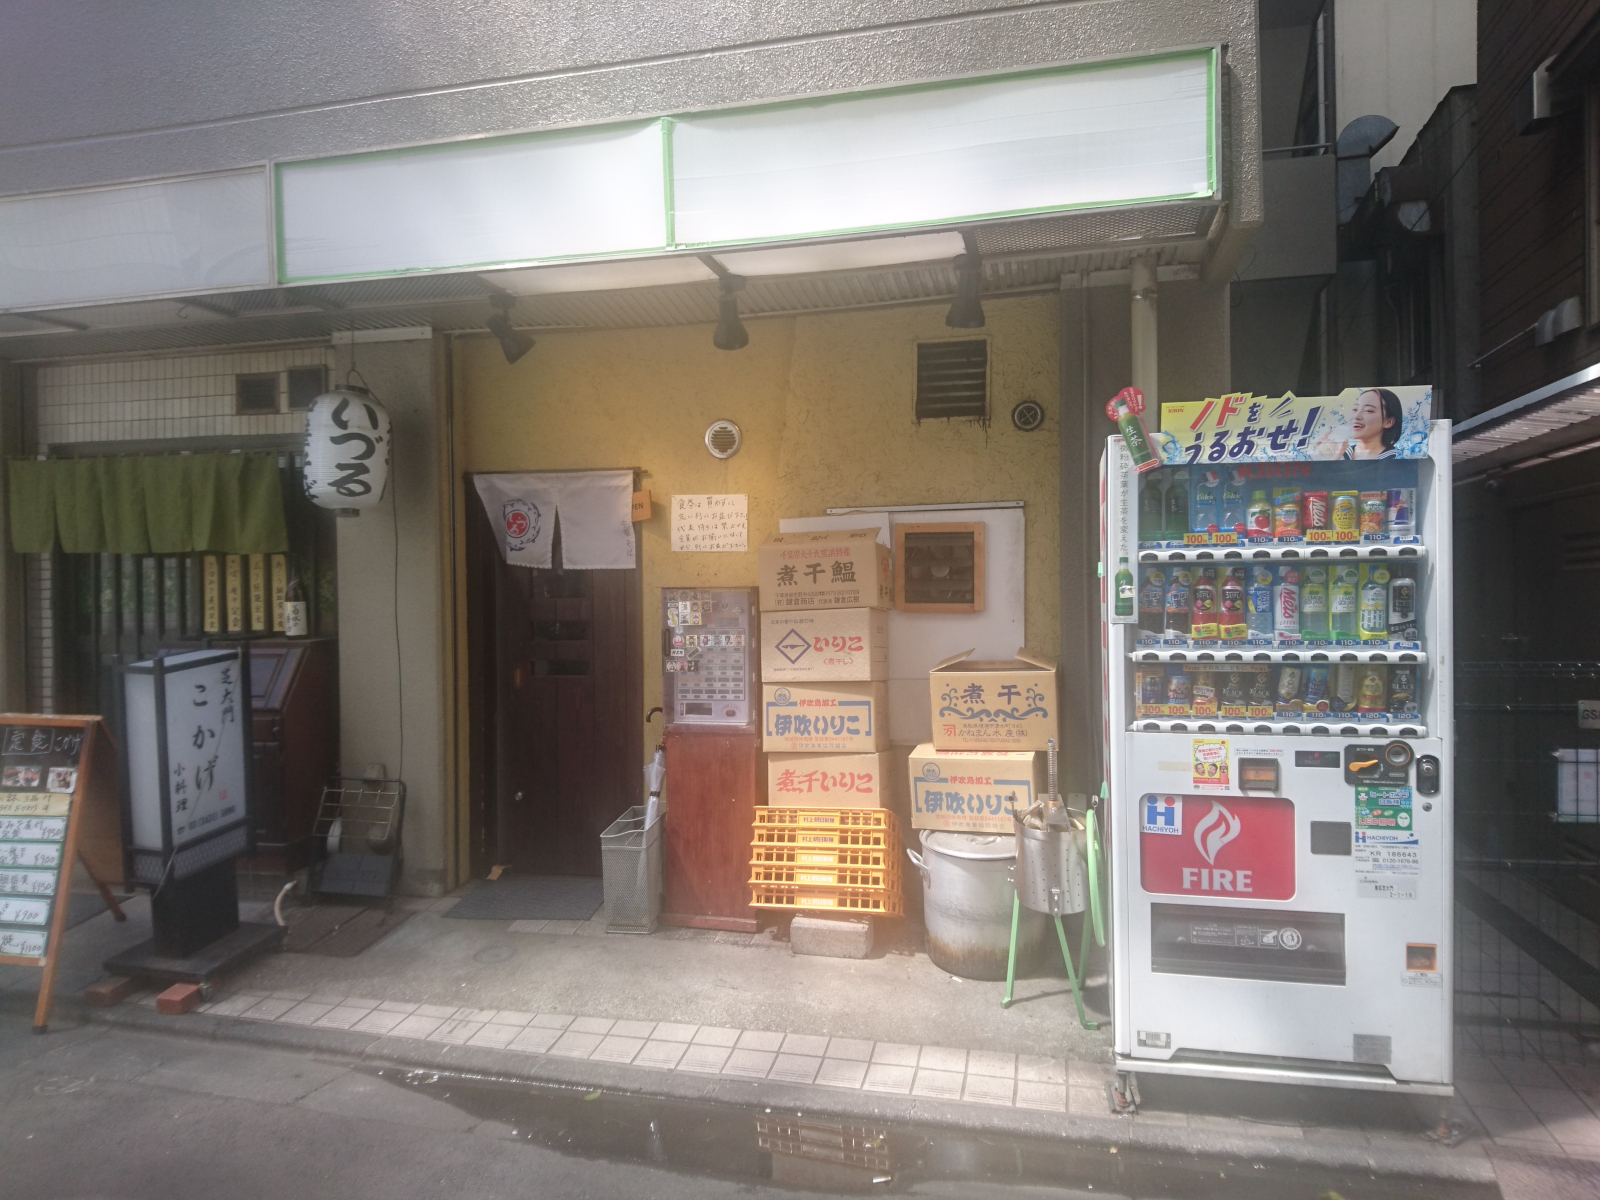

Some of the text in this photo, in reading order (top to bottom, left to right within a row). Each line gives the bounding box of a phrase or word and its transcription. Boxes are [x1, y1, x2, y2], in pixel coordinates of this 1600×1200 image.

[1189, 396, 1263, 431] ノドを
[1126, 426, 1142, 446] 生茶
[1185, 406, 1323, 463] うるおせ!
[328, 397, 383, 497] いづる
[1238, 462, 1311, 479] KIRIN
[1313, 498, 1324, 527] Mets
[1186, 534, 1208, 543] 100円
[1214, 534, 1236, 542] 100円
[1309, 532, 1331, 541] 100円
[1336, 531, 1357, 540] 100円
[780, 547, 851, 560] 千葉県九十九里浜特産
[1280, 587, 1298, 619] Mets
[813, 636, 864, 652] いりこ
[221, 668, 234, 723] 芝大門
[960, 683, 1022, 705] 煮干
[799, 699, 837, 707] 伊吹島加工
[1144, 705, 1165, 714] 100円
[1168, 706, 1188, 714] 100円
[1194, 706, 1215, 715] 100円
[1224, 707, 1244, 716] 100円
[1250, 708, 1271, 717] 100円
[775, 714, 860, 736] 伊吹いりこ
[8, 730, 49, 752] 定食
[193, 684, 219, 791] こかげ
[776, 769, 873, 794] 煮干いりこ
[949, 776, 992, 786] 伊吹島加工
[173, 763, 188, 813] 小料理
[1370, 790, 1410, 799] ヒートポンプ
[924, 790, 1018, 815] 伊吹いりこ
[1358, 817, 1397, 827] LED照明
[42, 827, 62, 839] ¥950
[1142, 826, 1179, 834] HACHIYOH
[34, 853, 55, 866] ¥900
[32, 880, 52, 893] ¥950
[1182, 867, 1253, 893] FIRE
[15, 910, 39, 921] ¥900
